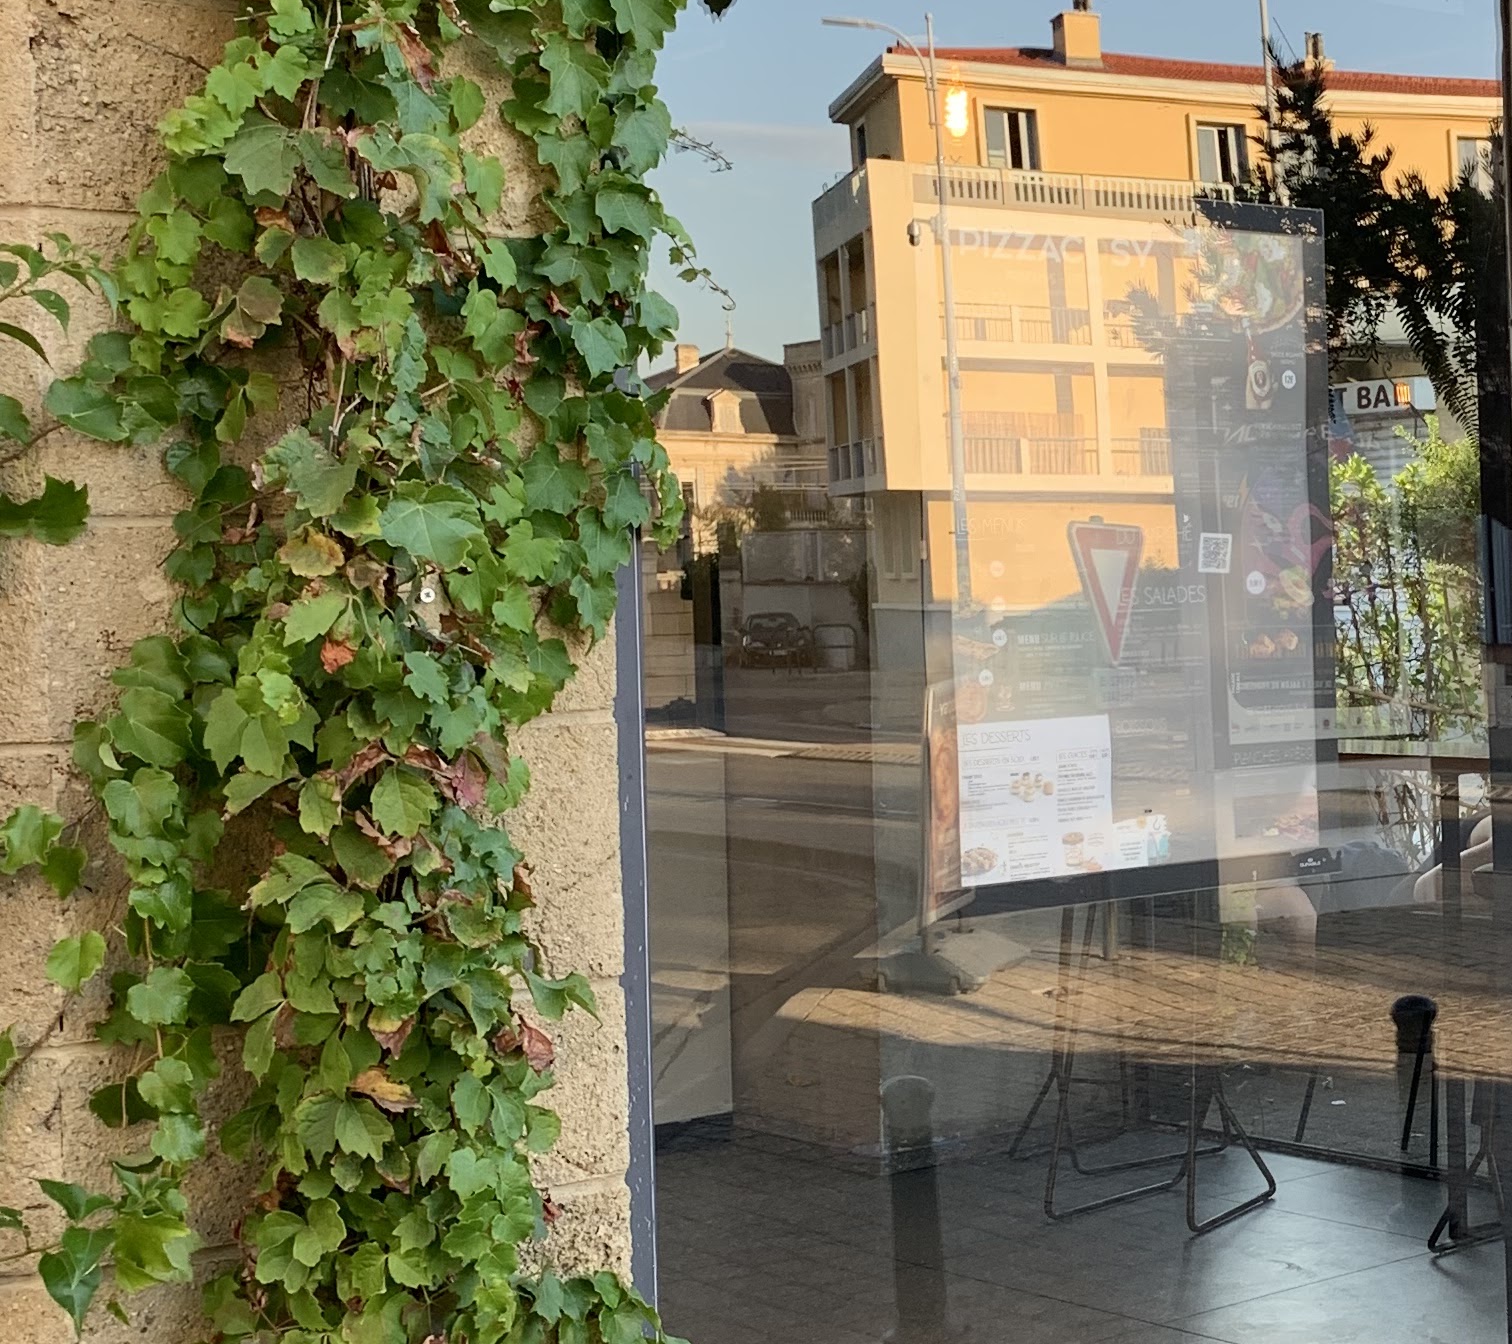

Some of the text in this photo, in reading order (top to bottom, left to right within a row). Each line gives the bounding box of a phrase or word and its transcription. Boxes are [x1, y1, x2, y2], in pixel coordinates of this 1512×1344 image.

[958, 230, 1156, 268] PIZZACSY
[1143, 584, 1207, 605] SALADES
[981, 729, 1032, 745] DESSERTS
